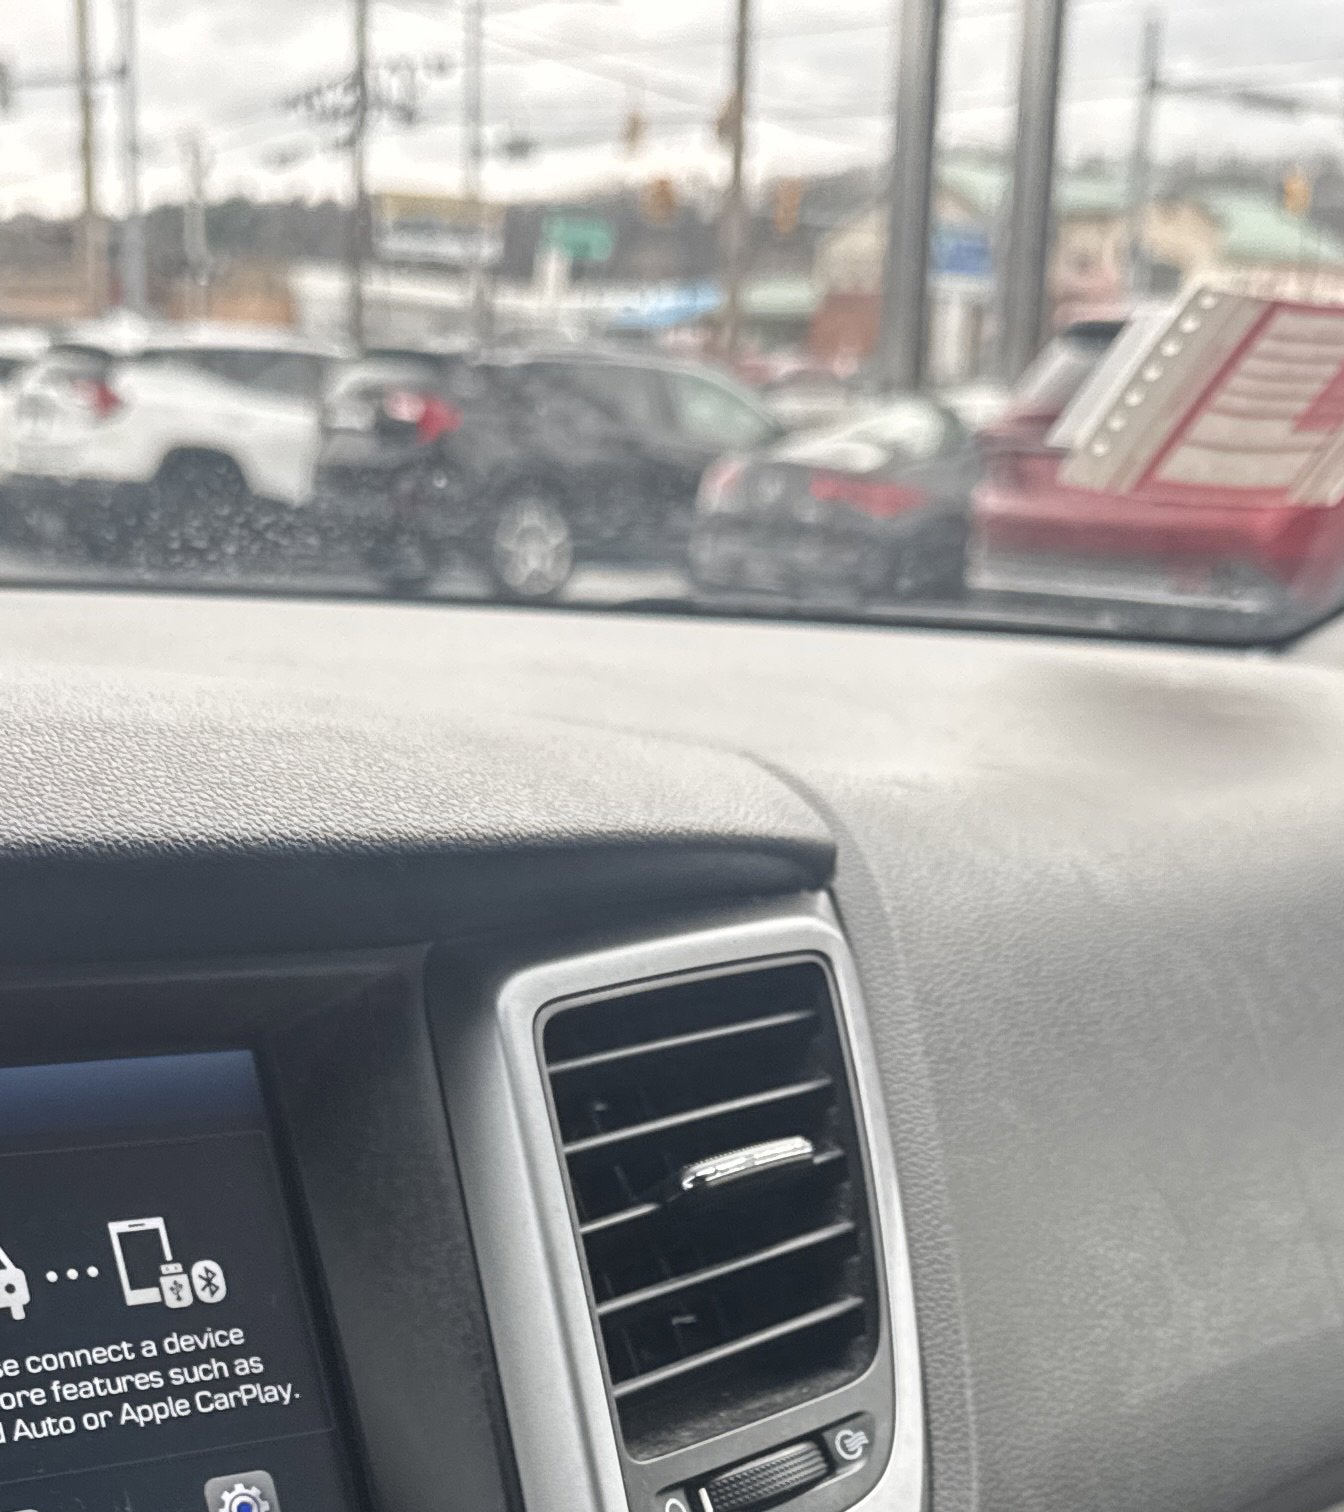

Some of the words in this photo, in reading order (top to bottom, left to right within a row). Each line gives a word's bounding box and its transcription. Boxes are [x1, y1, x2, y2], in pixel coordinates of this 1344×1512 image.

[25, 1340, 135, 1374] connect
[140, 1338, 157, 1358] a
[163, 1326, 245, 1355] device
[51, 1368, 164, 1402] features
[169, 1360, 229, 1387] such
[235, 1356, 264, 1376] as
[12, 1414, 76, 1443] Auto
[83, 1409, 112, 1430] or
[120, 1392, 191, 1427] Apple
[196, 1380, 301, 1416] CarPlay.
